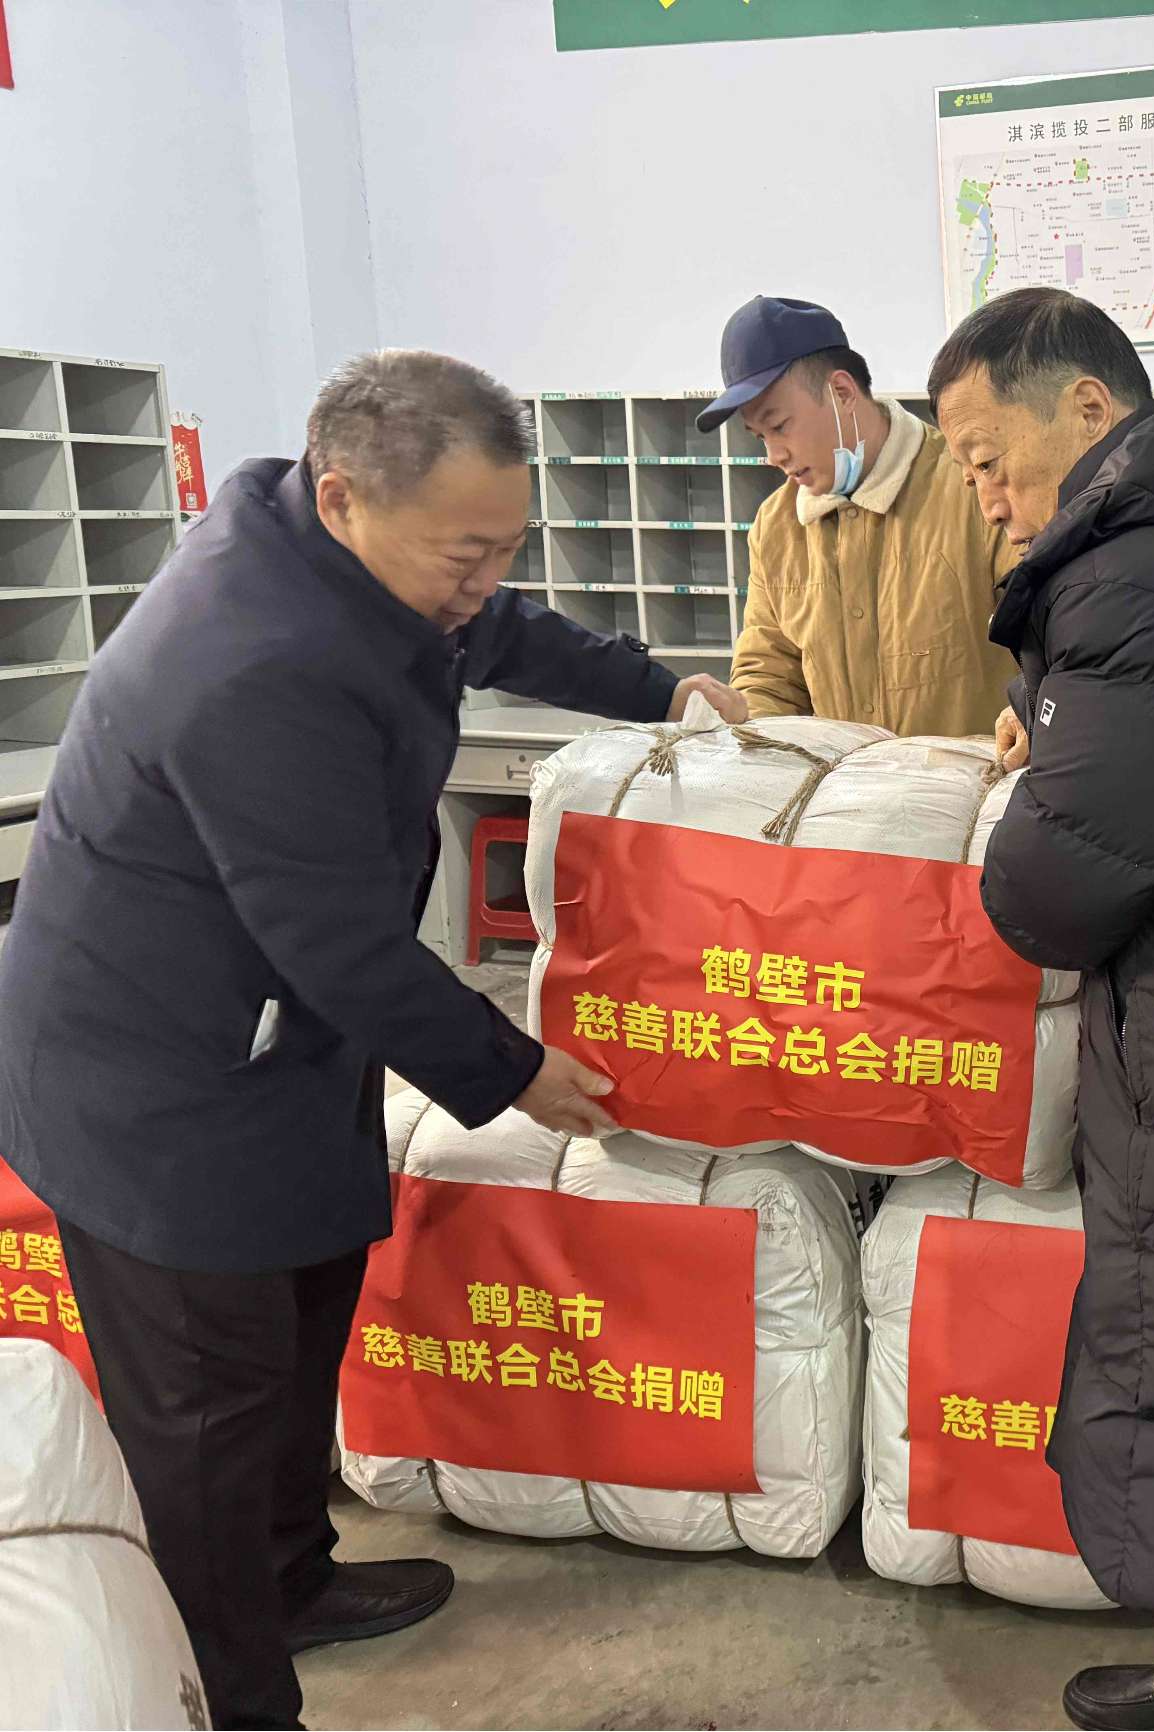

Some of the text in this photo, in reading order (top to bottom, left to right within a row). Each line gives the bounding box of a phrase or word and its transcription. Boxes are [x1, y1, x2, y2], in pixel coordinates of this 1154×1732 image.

[701, 945, 866, 1013] 鹤壁市
[572, 991, 1003, 1093] 慈善联合总会捐赠
[0, 1281, 85, 1334] 合总
[467, 1282, 606, 1341] 鹤壁市
[360, 1323, 725, 1421] 慈善联合总会捐赠
[940, 1394, 1057, 1451] 慈善
